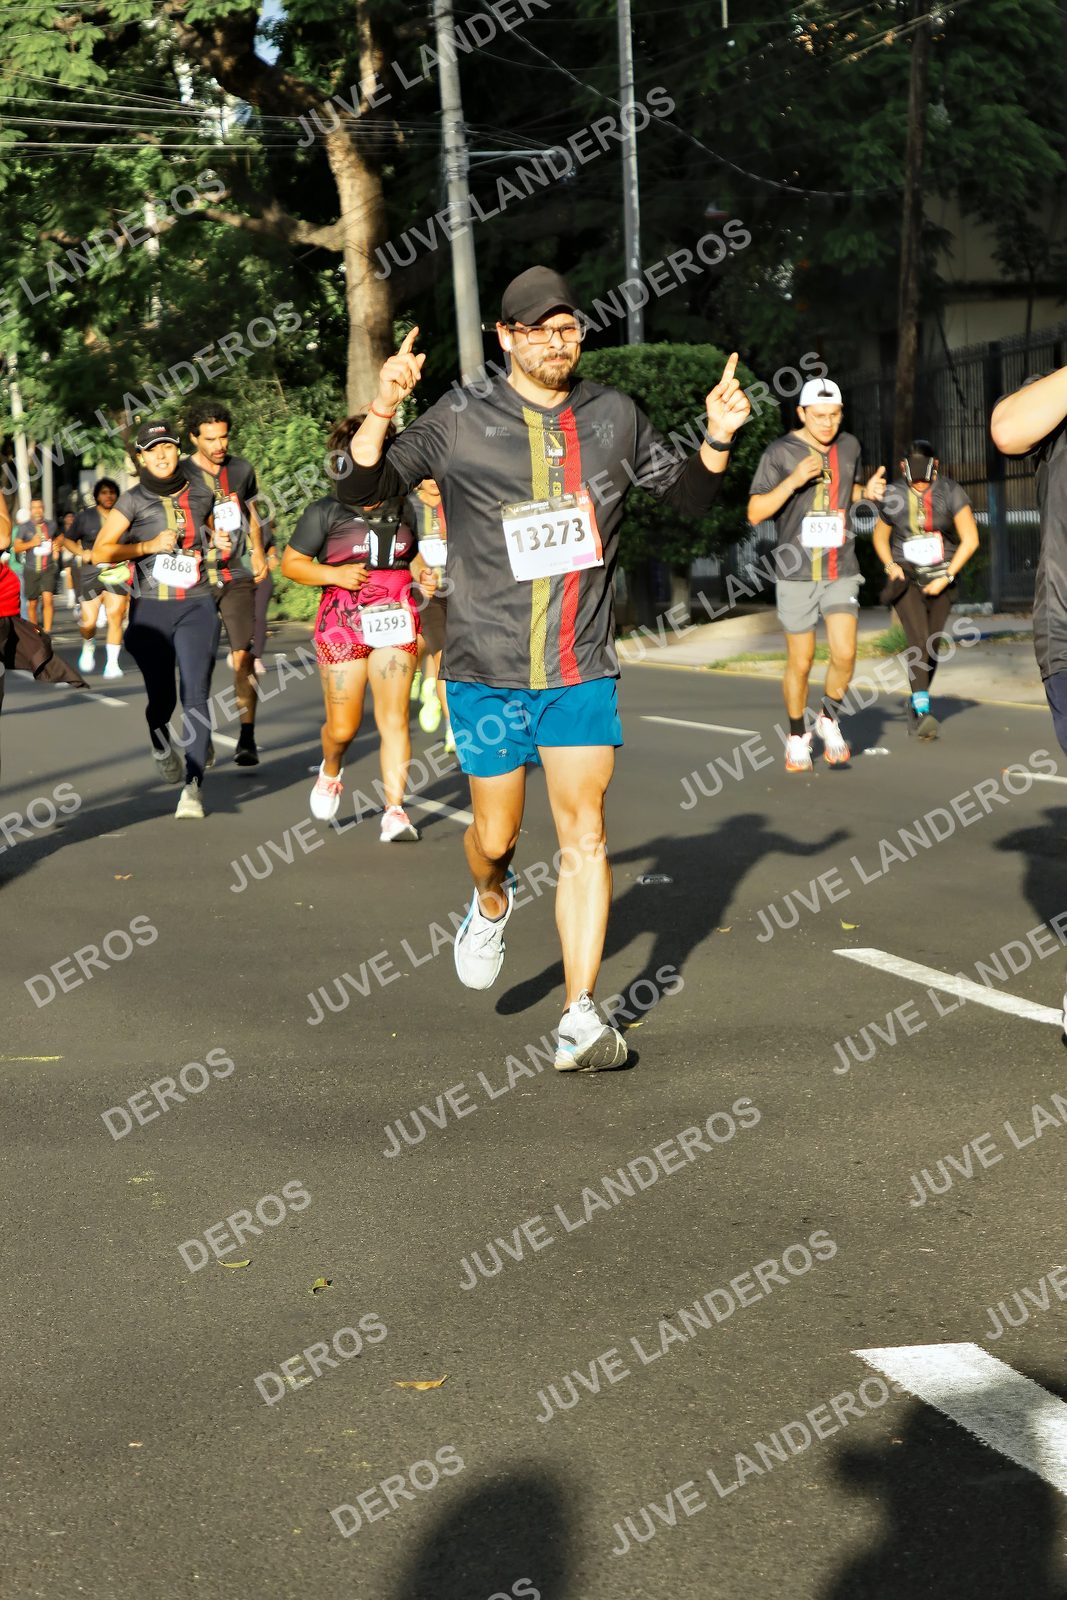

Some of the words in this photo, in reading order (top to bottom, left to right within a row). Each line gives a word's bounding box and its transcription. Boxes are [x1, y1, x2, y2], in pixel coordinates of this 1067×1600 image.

[511, 517, 586, 553] 13273
[810, 522, 837, 533] 8574
[162, 557, 192, 573] 8868
[368, 614, 407, 633] 12593
